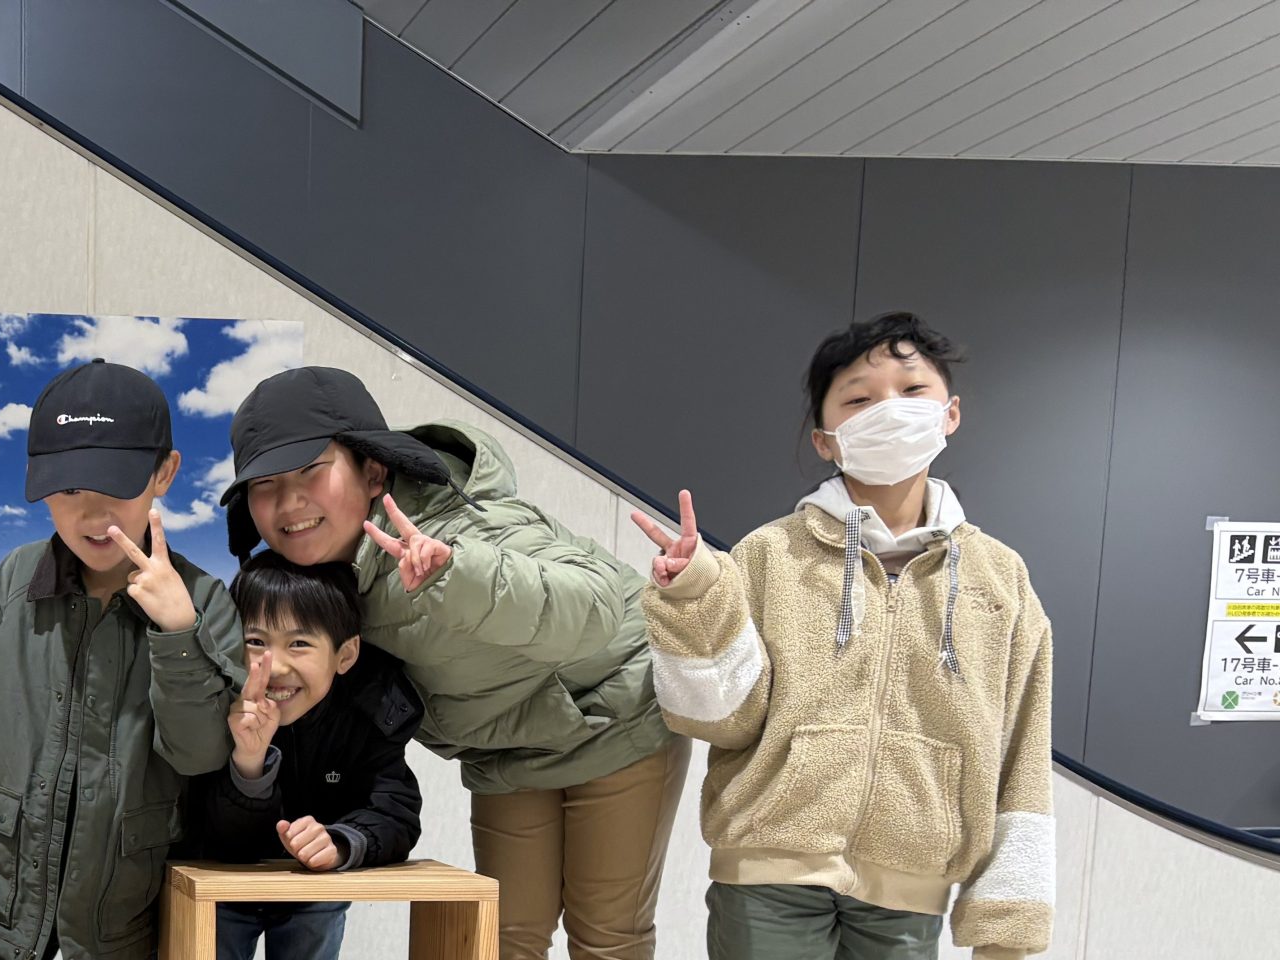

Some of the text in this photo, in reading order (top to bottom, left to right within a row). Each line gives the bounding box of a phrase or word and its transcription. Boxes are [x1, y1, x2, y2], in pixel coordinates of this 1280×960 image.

[57, 413, 114, 425] Champion
[1247, 587, 1265, 596] Car
[1235, 676, 1254, 685] Car
